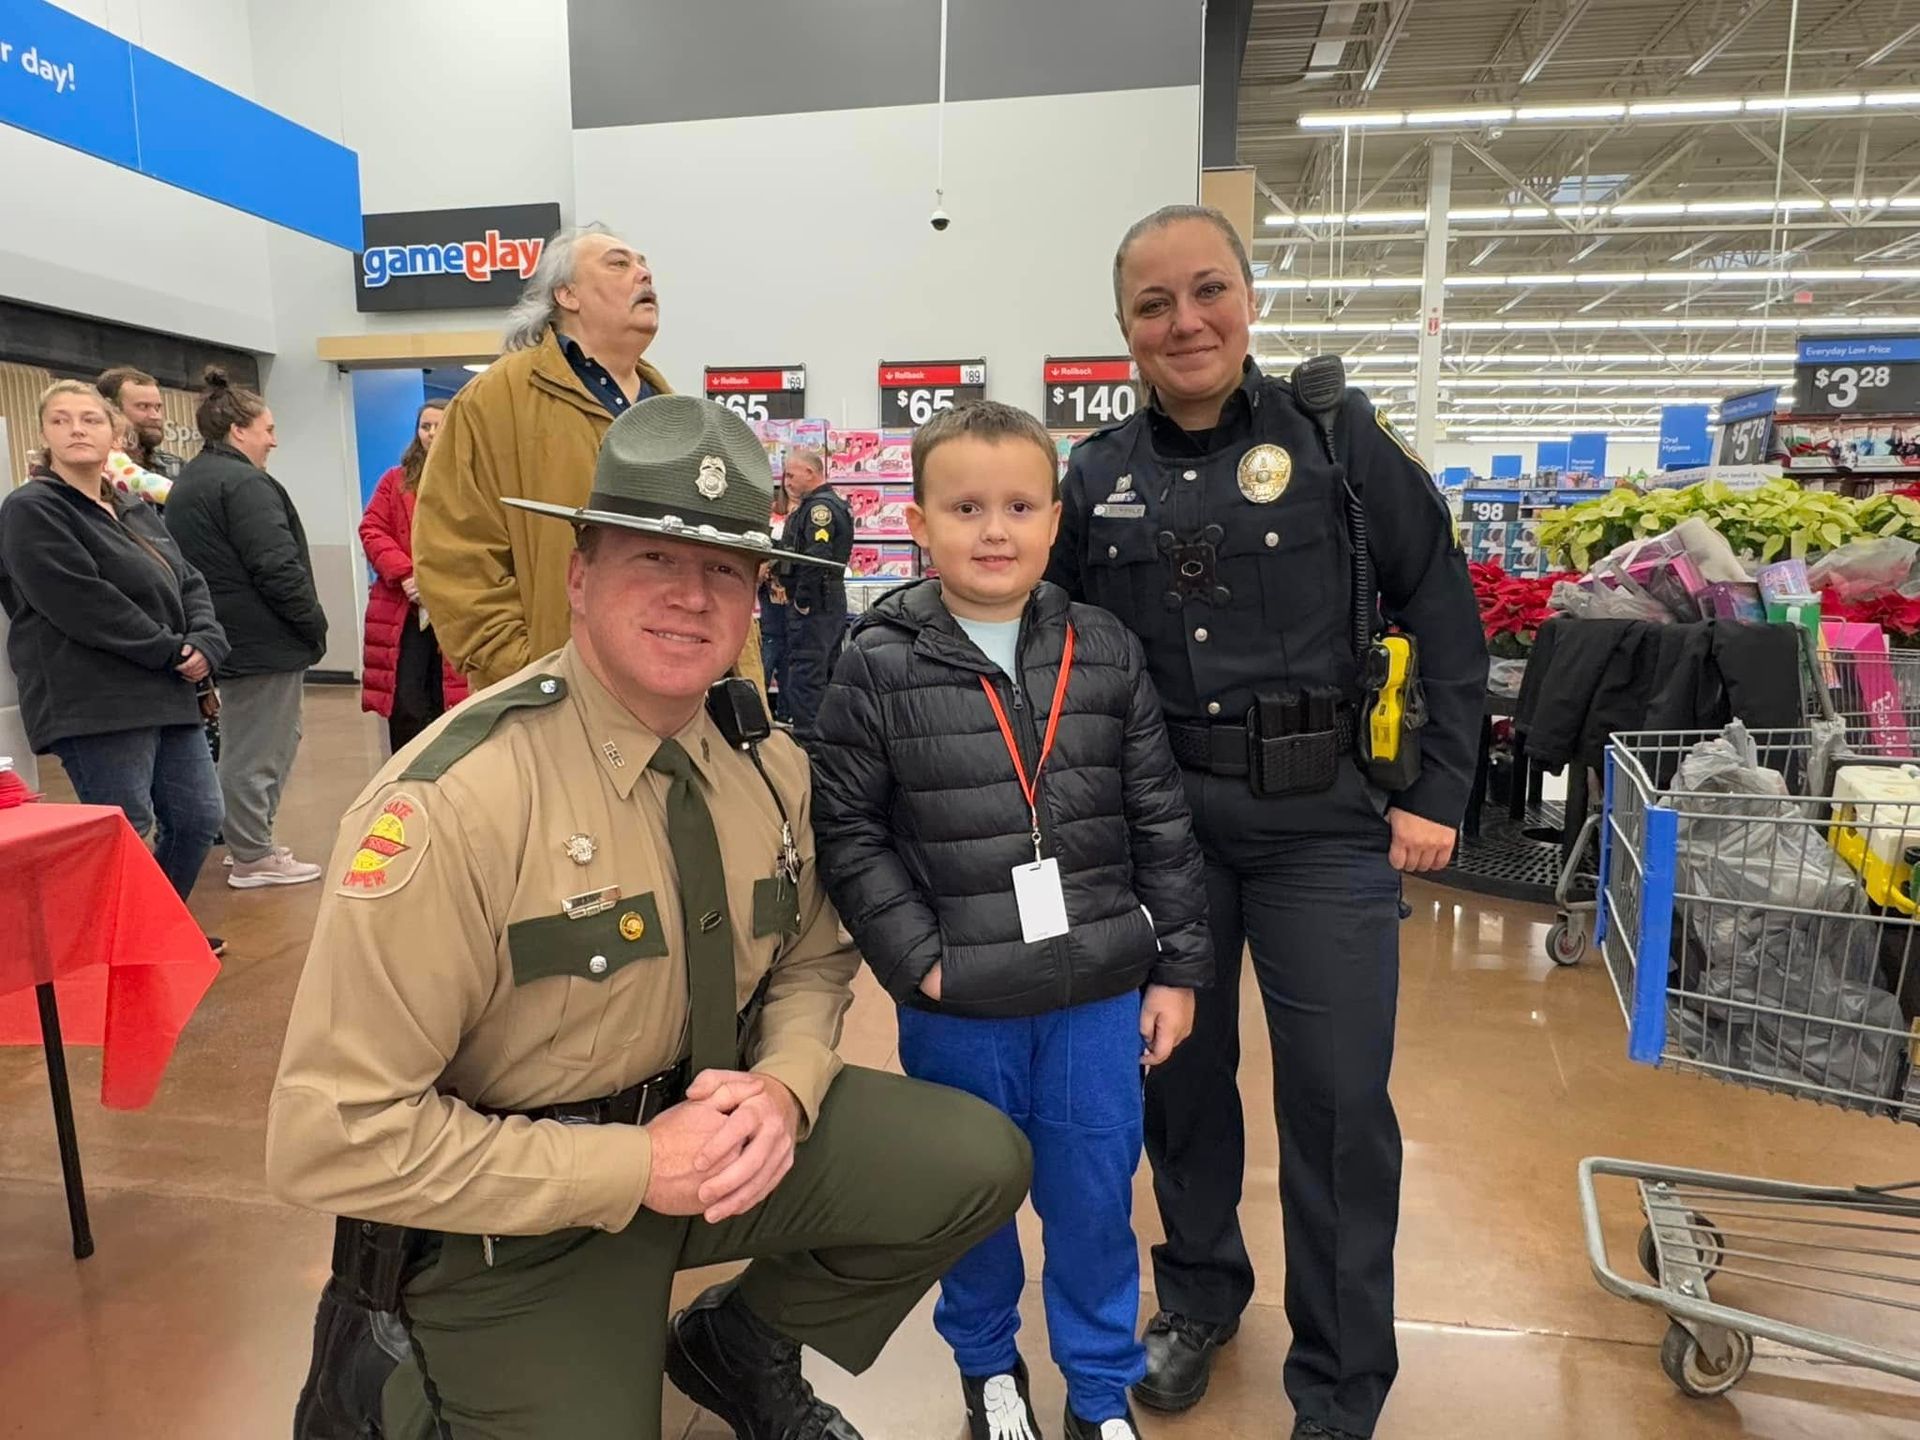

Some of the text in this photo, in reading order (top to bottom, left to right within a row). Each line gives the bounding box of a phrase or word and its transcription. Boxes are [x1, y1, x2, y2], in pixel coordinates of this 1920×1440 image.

[21, 46, 76, 93] day!
[363, 229, 545, 288] gameplay
[1806, 345, 1891, 357] Everyday Low Price
[897, 389, 954, 425] $65
[1053, 385, 1136, 422] $140
[1472, 502, 1503, 521] $98
